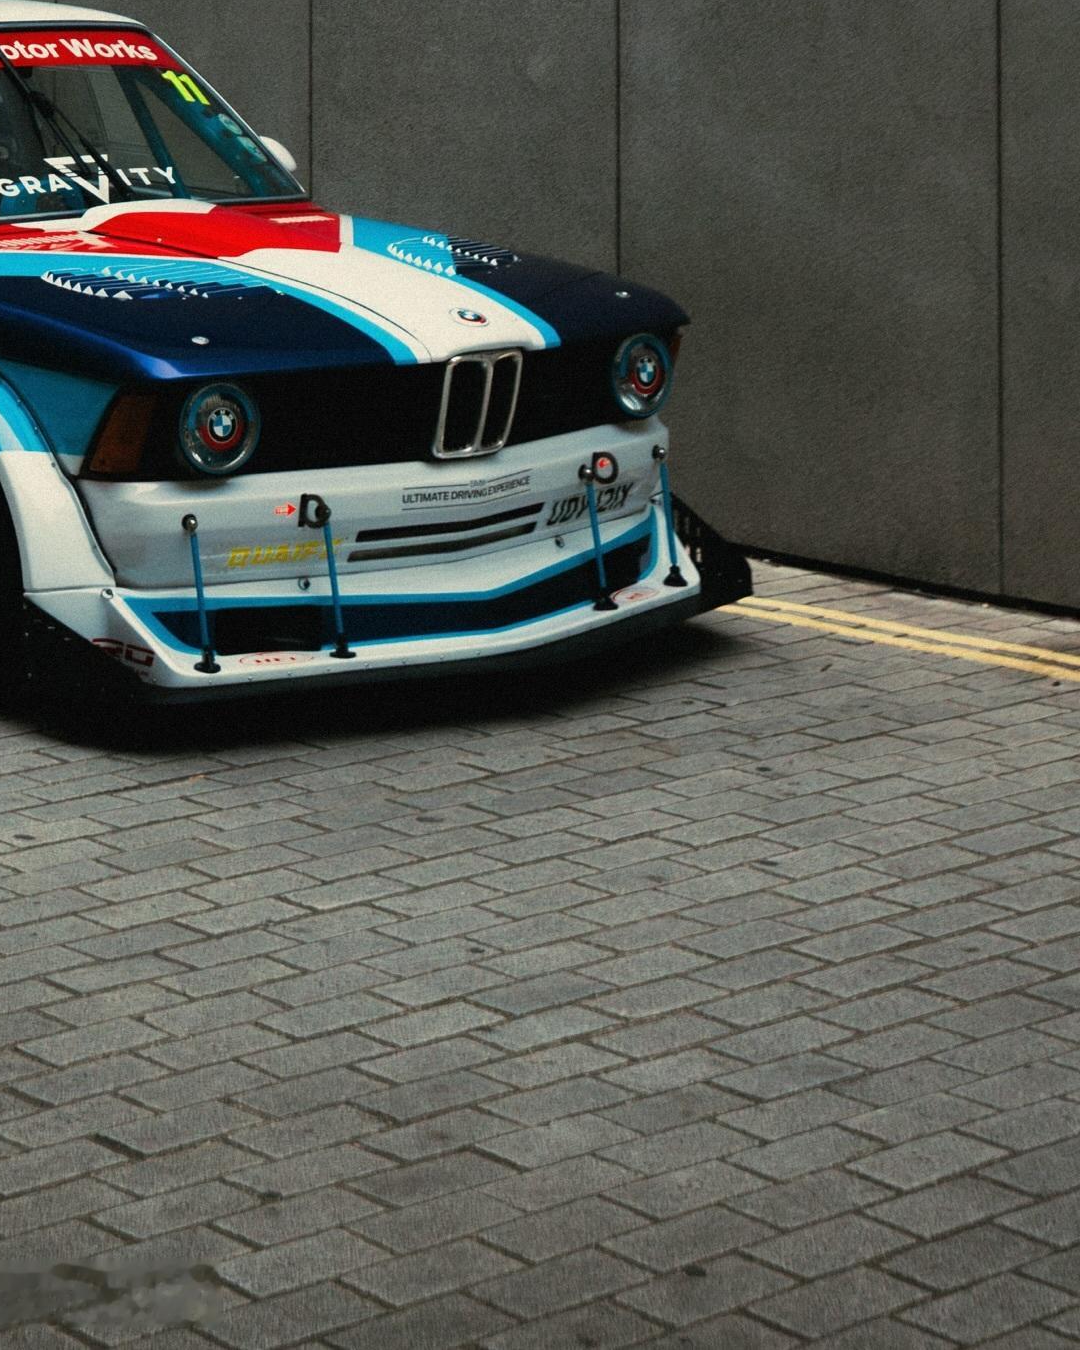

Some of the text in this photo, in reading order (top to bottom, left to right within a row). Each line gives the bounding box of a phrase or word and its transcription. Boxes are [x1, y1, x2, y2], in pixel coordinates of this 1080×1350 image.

[59, 38, 158, 61] Works
[161, 70, 211, 105] 11
[402, 476, 530, 504] ULTIMATE DRIVING EXPERIENCE
